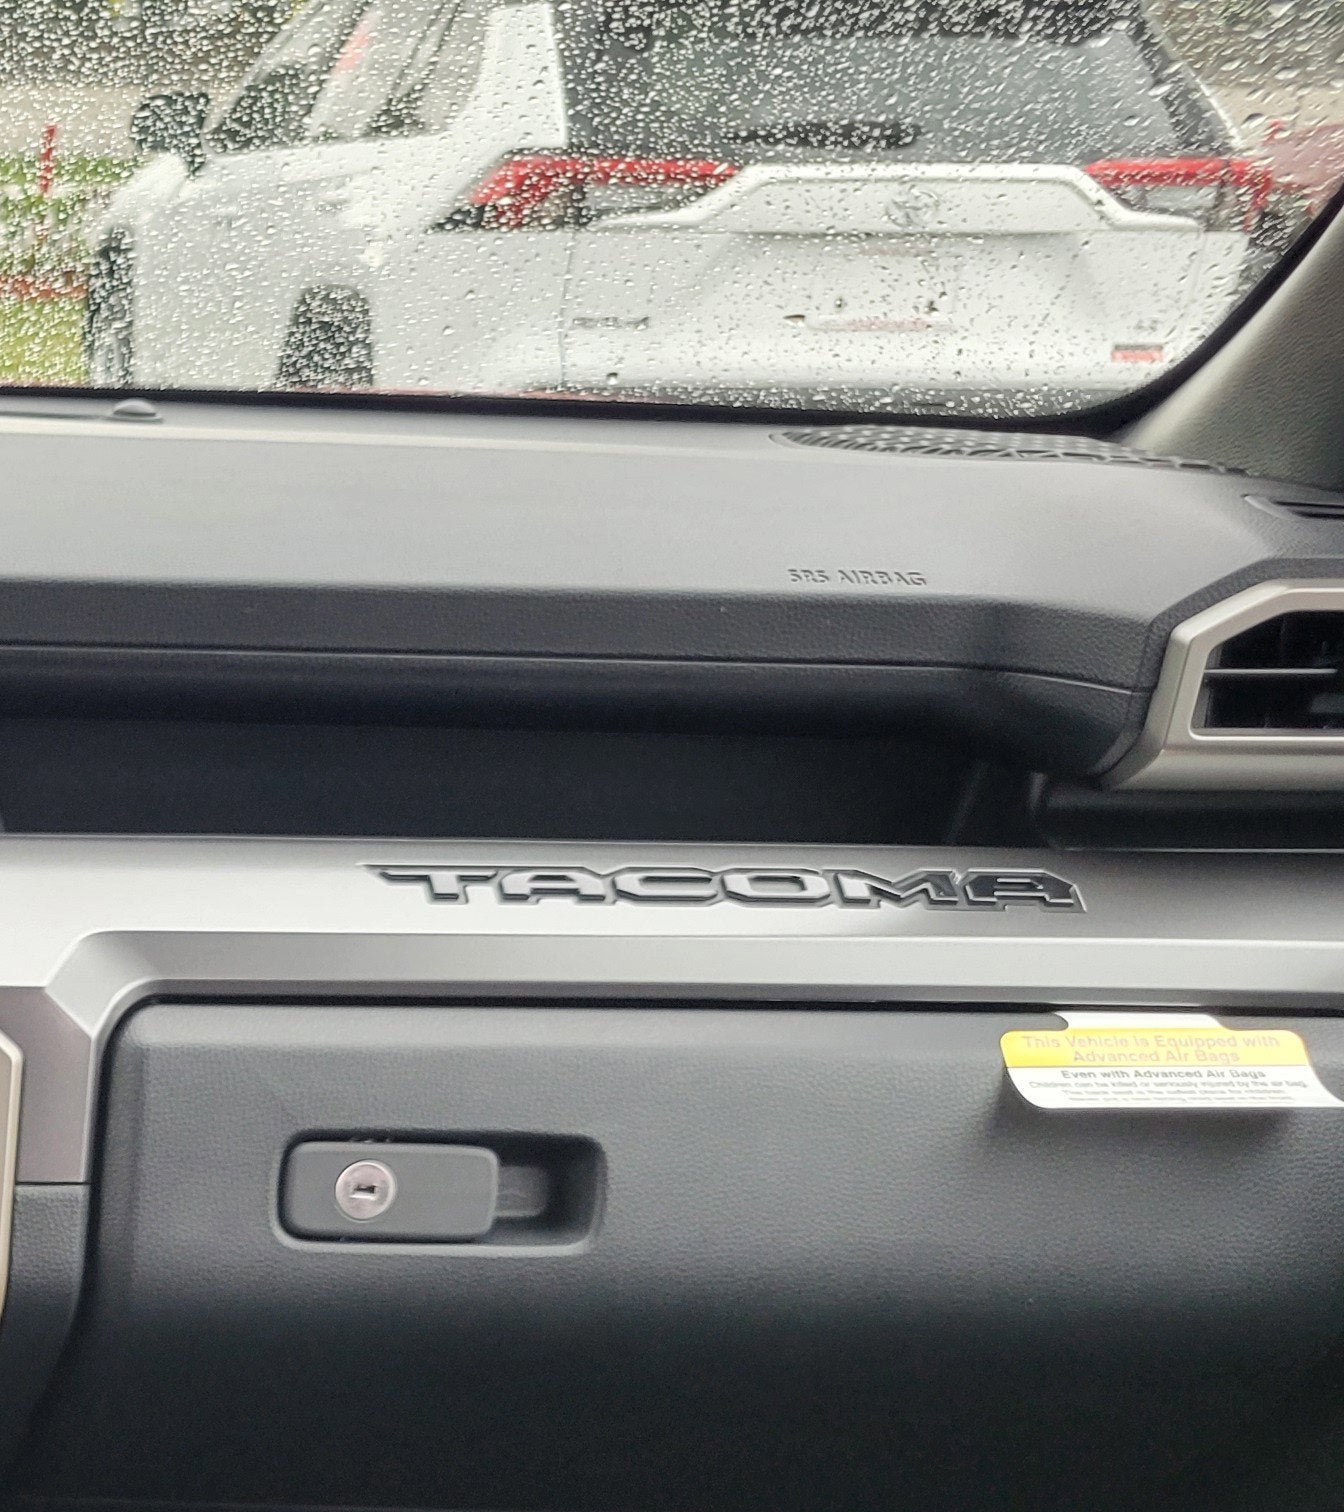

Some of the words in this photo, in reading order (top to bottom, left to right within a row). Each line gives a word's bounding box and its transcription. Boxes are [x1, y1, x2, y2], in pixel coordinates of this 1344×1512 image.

[787, 568, 829, 583] SRS
[837, 569, 928, 586] AIRBAG
[362, 864, 1088, 912] TACOMA
[1022, 1036, 1060, 1048] This
[1066, 1036, 1129, 1048] Vehicle
[1134, 1036, 1149, 1047] is
[1155, 1035, 1238, 1050] Equipped
[1244, 1036, 1280, 1047] with
[1074, 1051, 1159, 1062] Advanced
[1166, 1051, 1188, 1062] Air
[1196, 1050, 1240, 1065] Bags
[1061, 1070, 1096, 1079] Even
[1101, 1070, 1130, 1079] with
[1134, 1070, 1203, 1079] Advanced
[1207, 1070, 1225, 1078] Air
[1230, 1070, 1266, 1080] Bags
